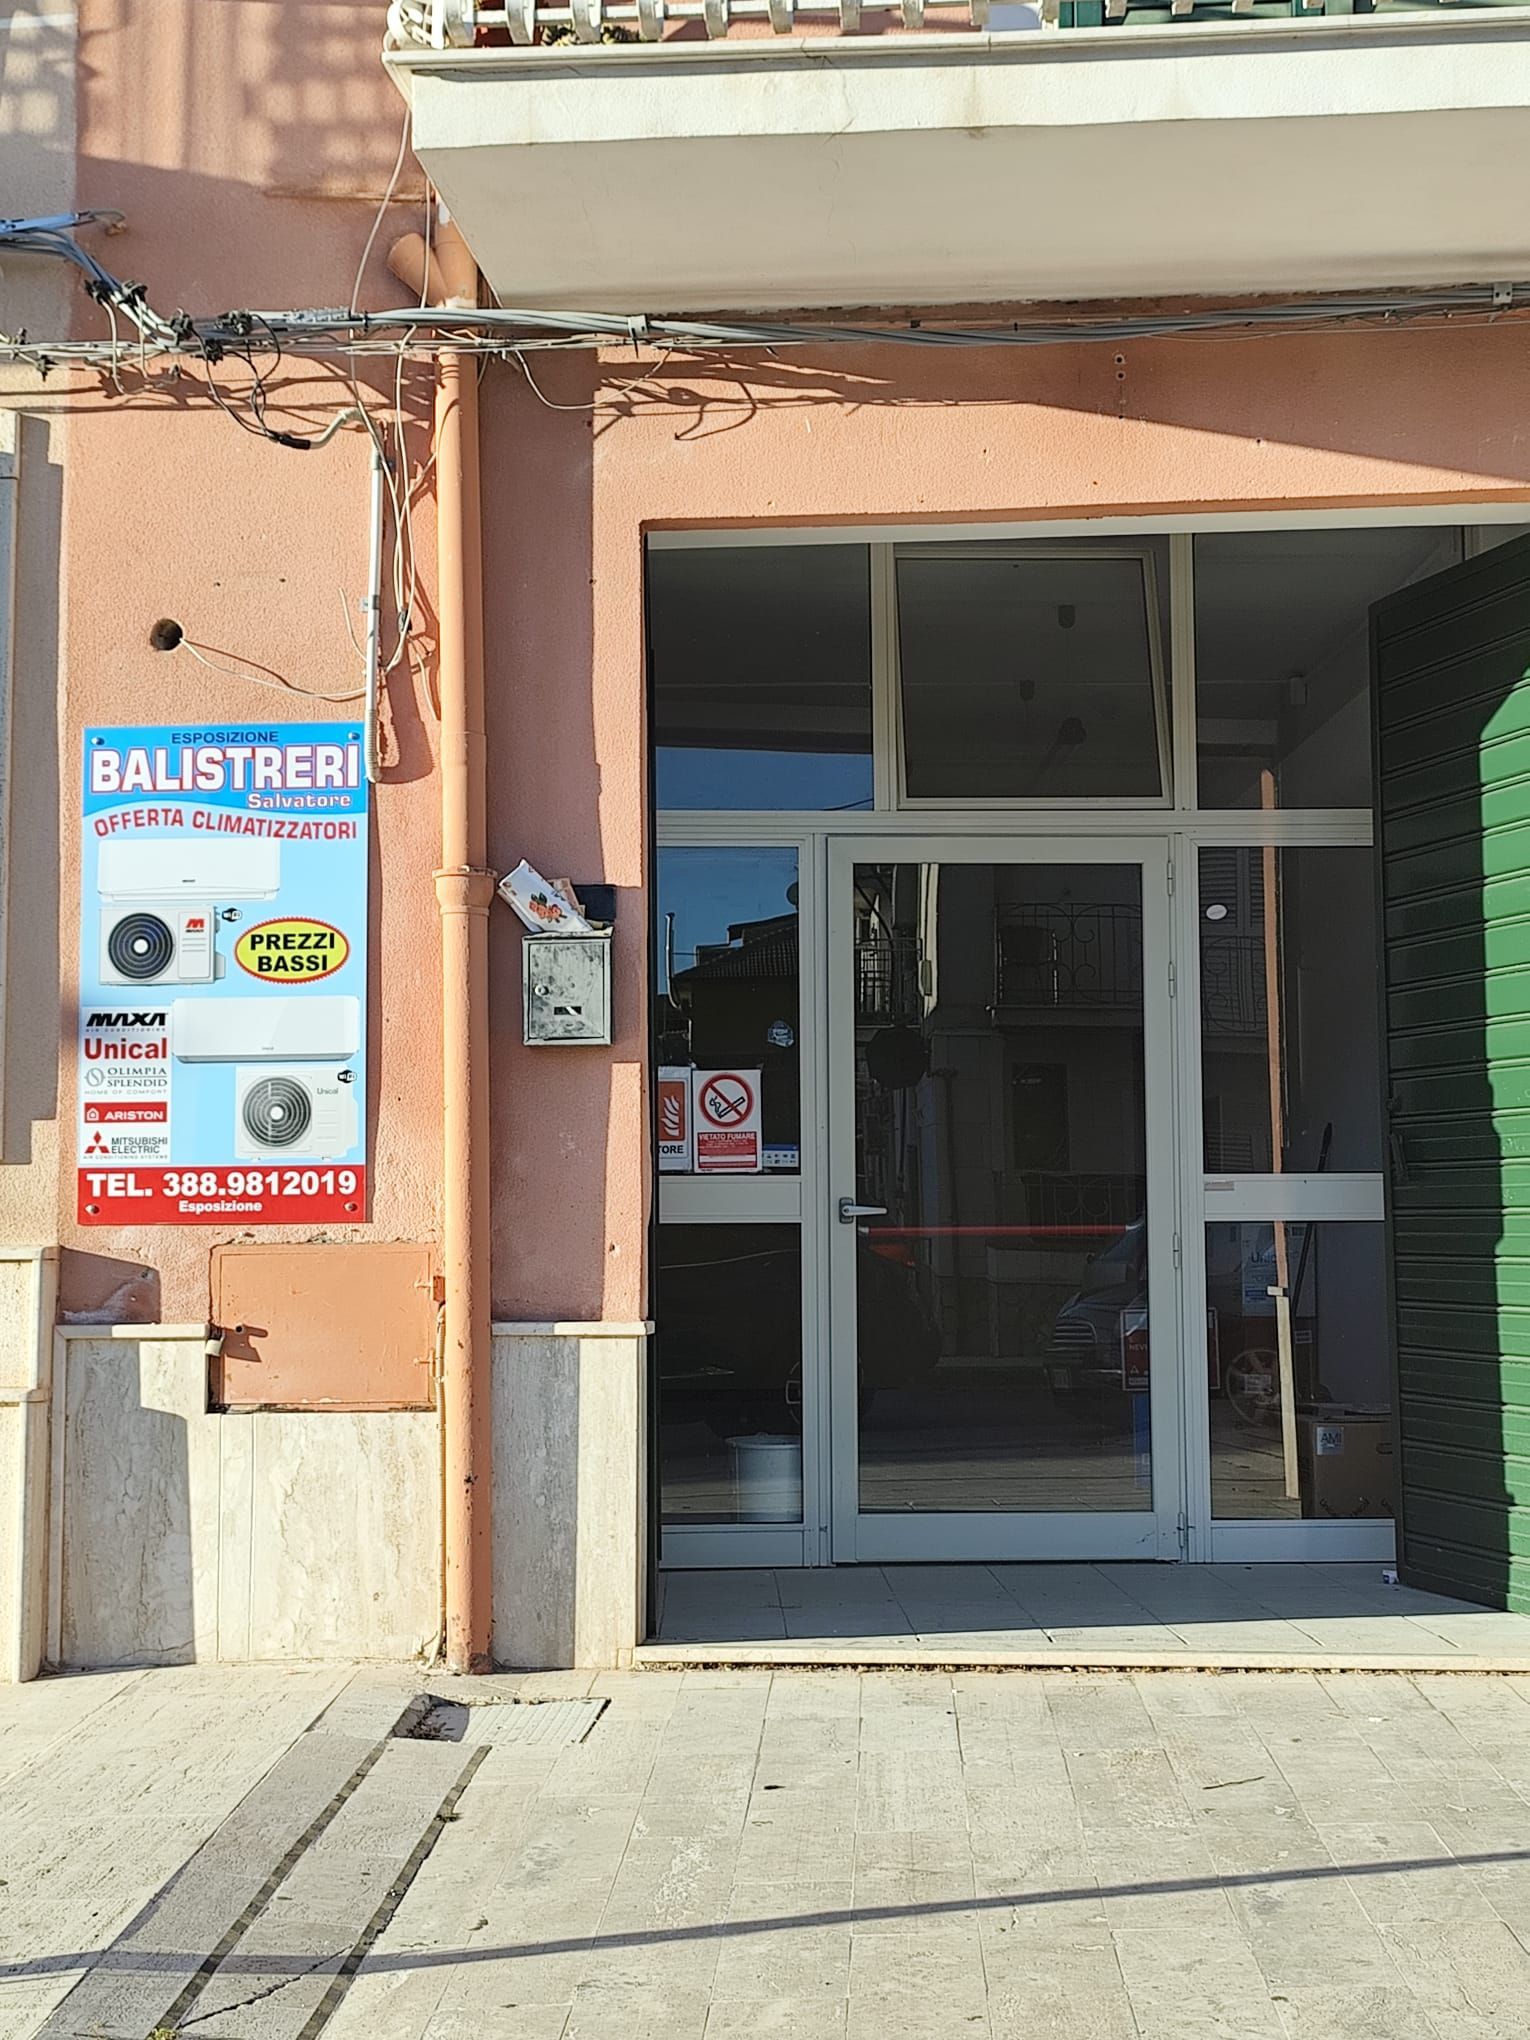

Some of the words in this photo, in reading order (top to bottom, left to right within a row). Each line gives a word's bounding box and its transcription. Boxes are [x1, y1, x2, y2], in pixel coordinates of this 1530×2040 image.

[171, 731, 279, 745] ESPOSIZIONE
[91, 745, 361, 793] BALISTRERI
[247, 793, 352, 809] Salvatore
[94, 808, 184, 837] OFFERTA
[192, 810, 357, 840] CLIMATIZZATORI
[250, 933, 335, 951] PREZZI
[257, 955, 328, 972] BASSI
[86, 1012, 167, 1027] MAXA
[84, 1037, 168, 1060] Unical
[107, 1067, 167, 1075] OLIMPIA
[107, 1079, 168, 1087] SPLENDID
[317, 1087, 339, 1096] Unical
[105, 1110, 164, 1121] ARISTON
[111, 1136, 168, 1145] MITSUBISHI
[111, 1145, 160, 1154] ELECTRIC
[87, 1173, 152, 1197] TEL.
[162, 1171, 357, 1197] 388.9812019
[178, 1200, 262, 1215] Esposizione
